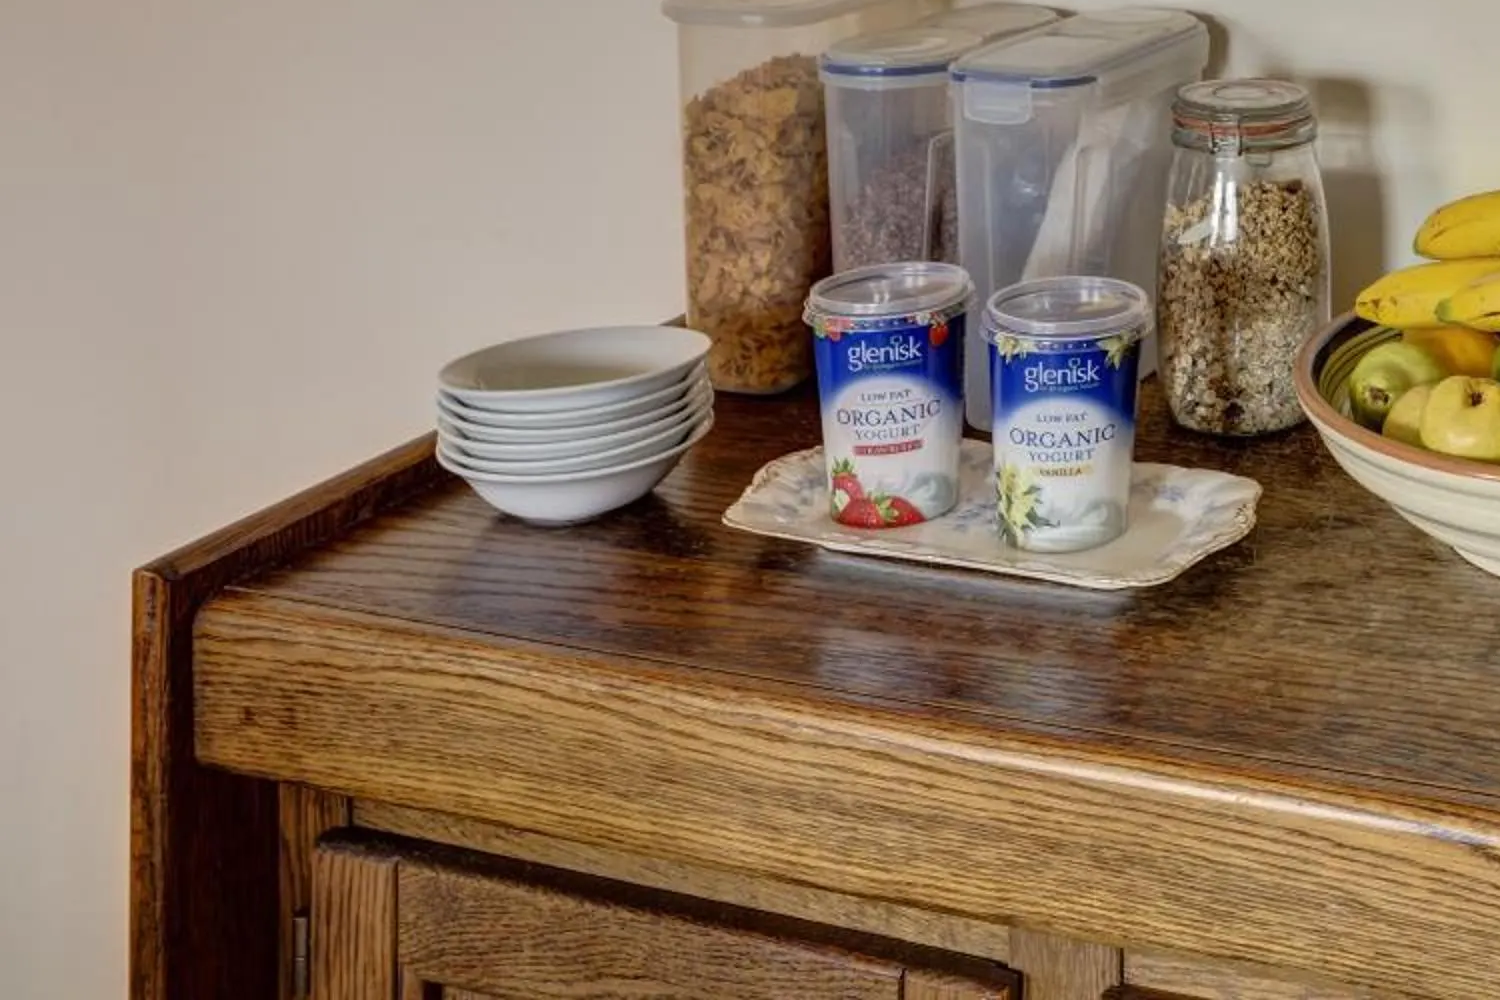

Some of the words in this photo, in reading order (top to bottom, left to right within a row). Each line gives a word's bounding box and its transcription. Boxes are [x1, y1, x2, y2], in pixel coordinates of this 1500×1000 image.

[848, 335, 923, 372] glenisk
[1024, 358, 1101, 392] glenisk
[861, 392, 886, 402] LOW
[888, 389, 912, 400] FAT
[837, 400, 941, 427] ORGANIC
[1036, 412, 1063, 423] LOW
[1065, 411, 1089, 421] FAT
[854, 424, 921, 441] YOGURT
[1009, 424, 1116, 448] ORGANIC
[1029, 448, 1096, 462] YOGURT
